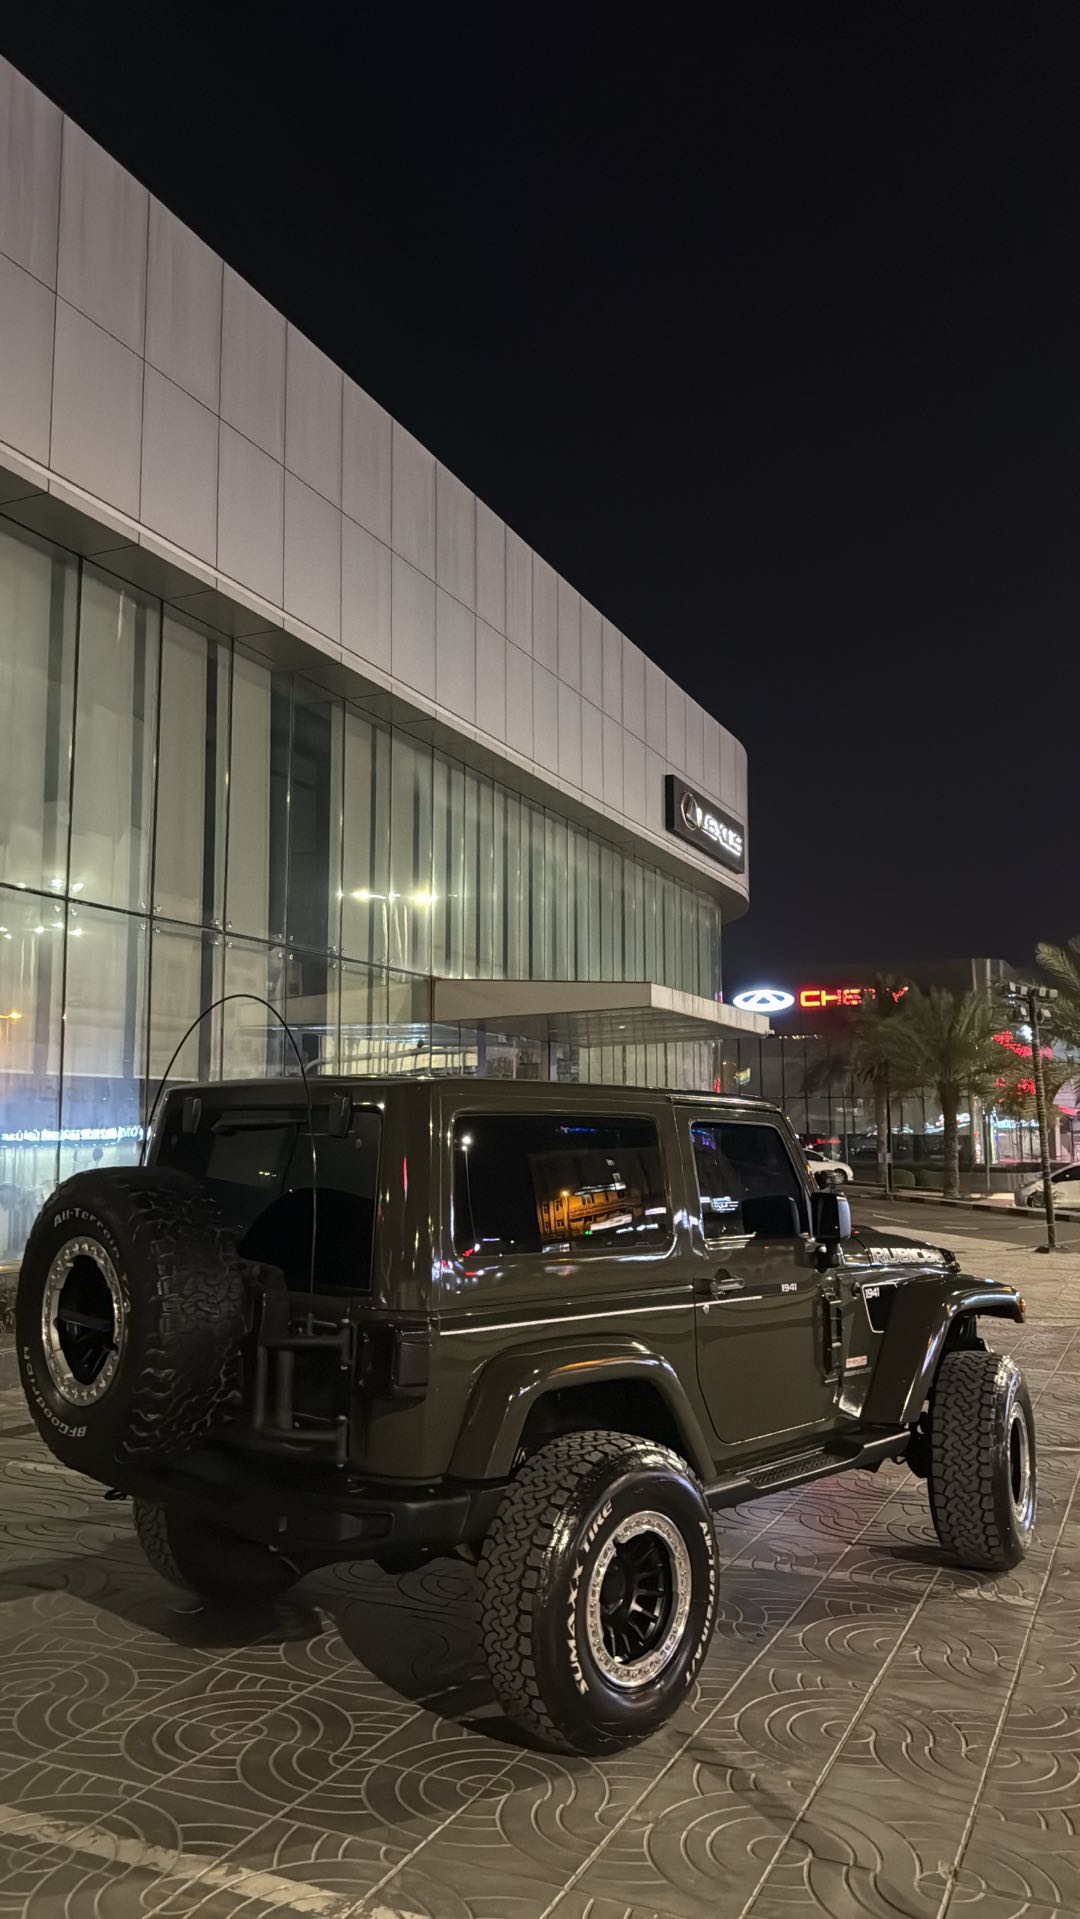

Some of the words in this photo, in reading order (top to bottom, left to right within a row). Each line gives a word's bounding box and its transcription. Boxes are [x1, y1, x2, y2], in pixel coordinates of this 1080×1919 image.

[799, 985, 909, 1007] CHEY
[781, 1283, 797, 1292] 1941
[865, 1287, 880, 1299] 1941
[23, 1345, 87, 1438] BFGoodrich
[566, 1559, 590, 1696] SUMAXX
[580, 1500, 613, 1553] TIRE
[698, 1521, 717, 1643] All-Terrain
